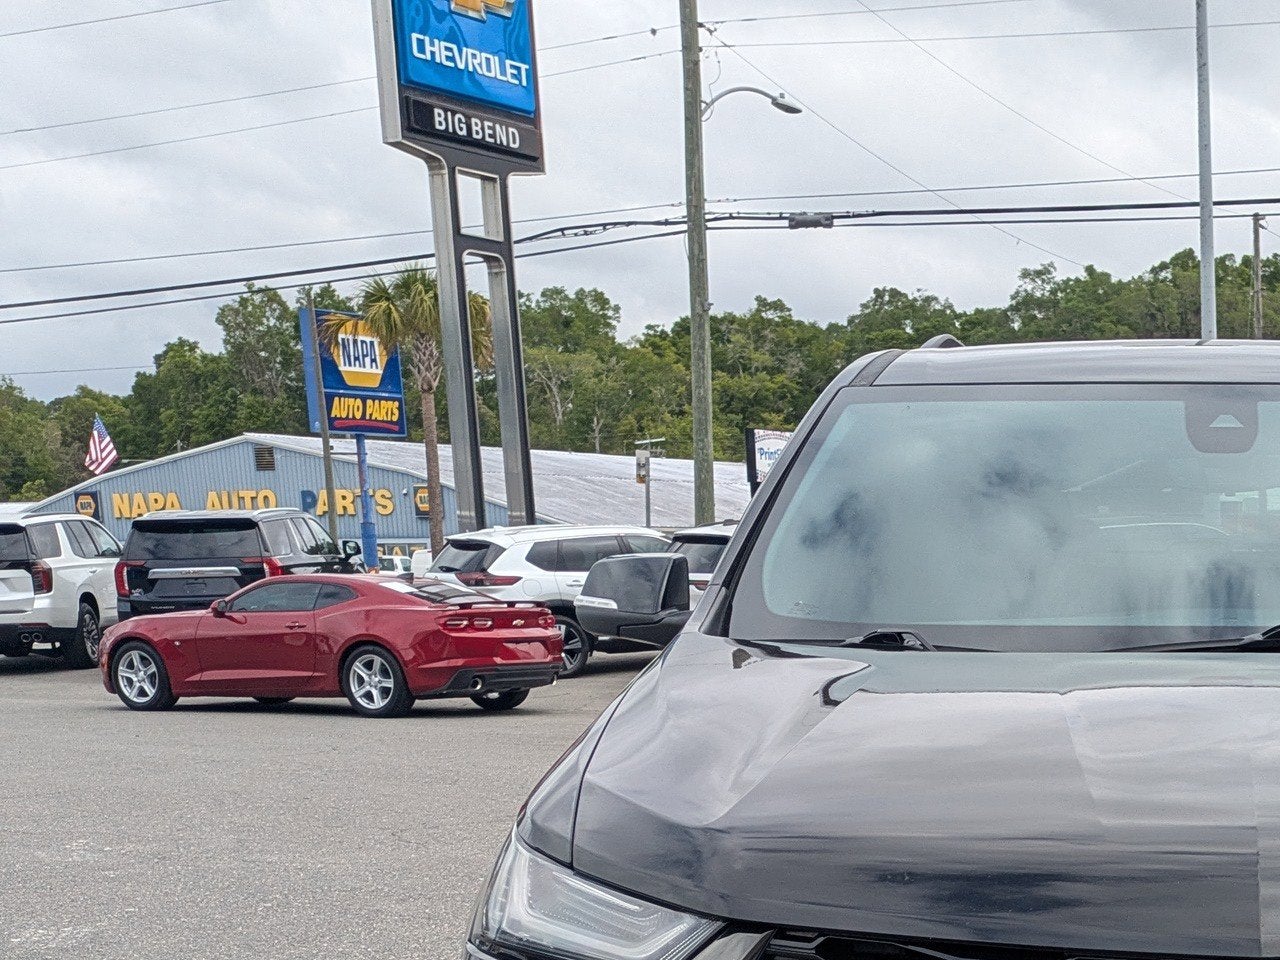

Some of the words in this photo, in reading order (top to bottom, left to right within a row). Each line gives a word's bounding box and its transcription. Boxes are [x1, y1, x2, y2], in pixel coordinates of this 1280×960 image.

[411, 33, 529, 87] CHEVROLET
[433, 108, 468, 136] BIG
[471, 117, 520, 149] BEND
[341, 337, 379, 370] NAPA
[331, 396, 363, 419] AUTO
[366, 400, 399, 421] PARTS
[112, 491, 182, 518] NAPA
[206, 489, 277, 511] AUTO
